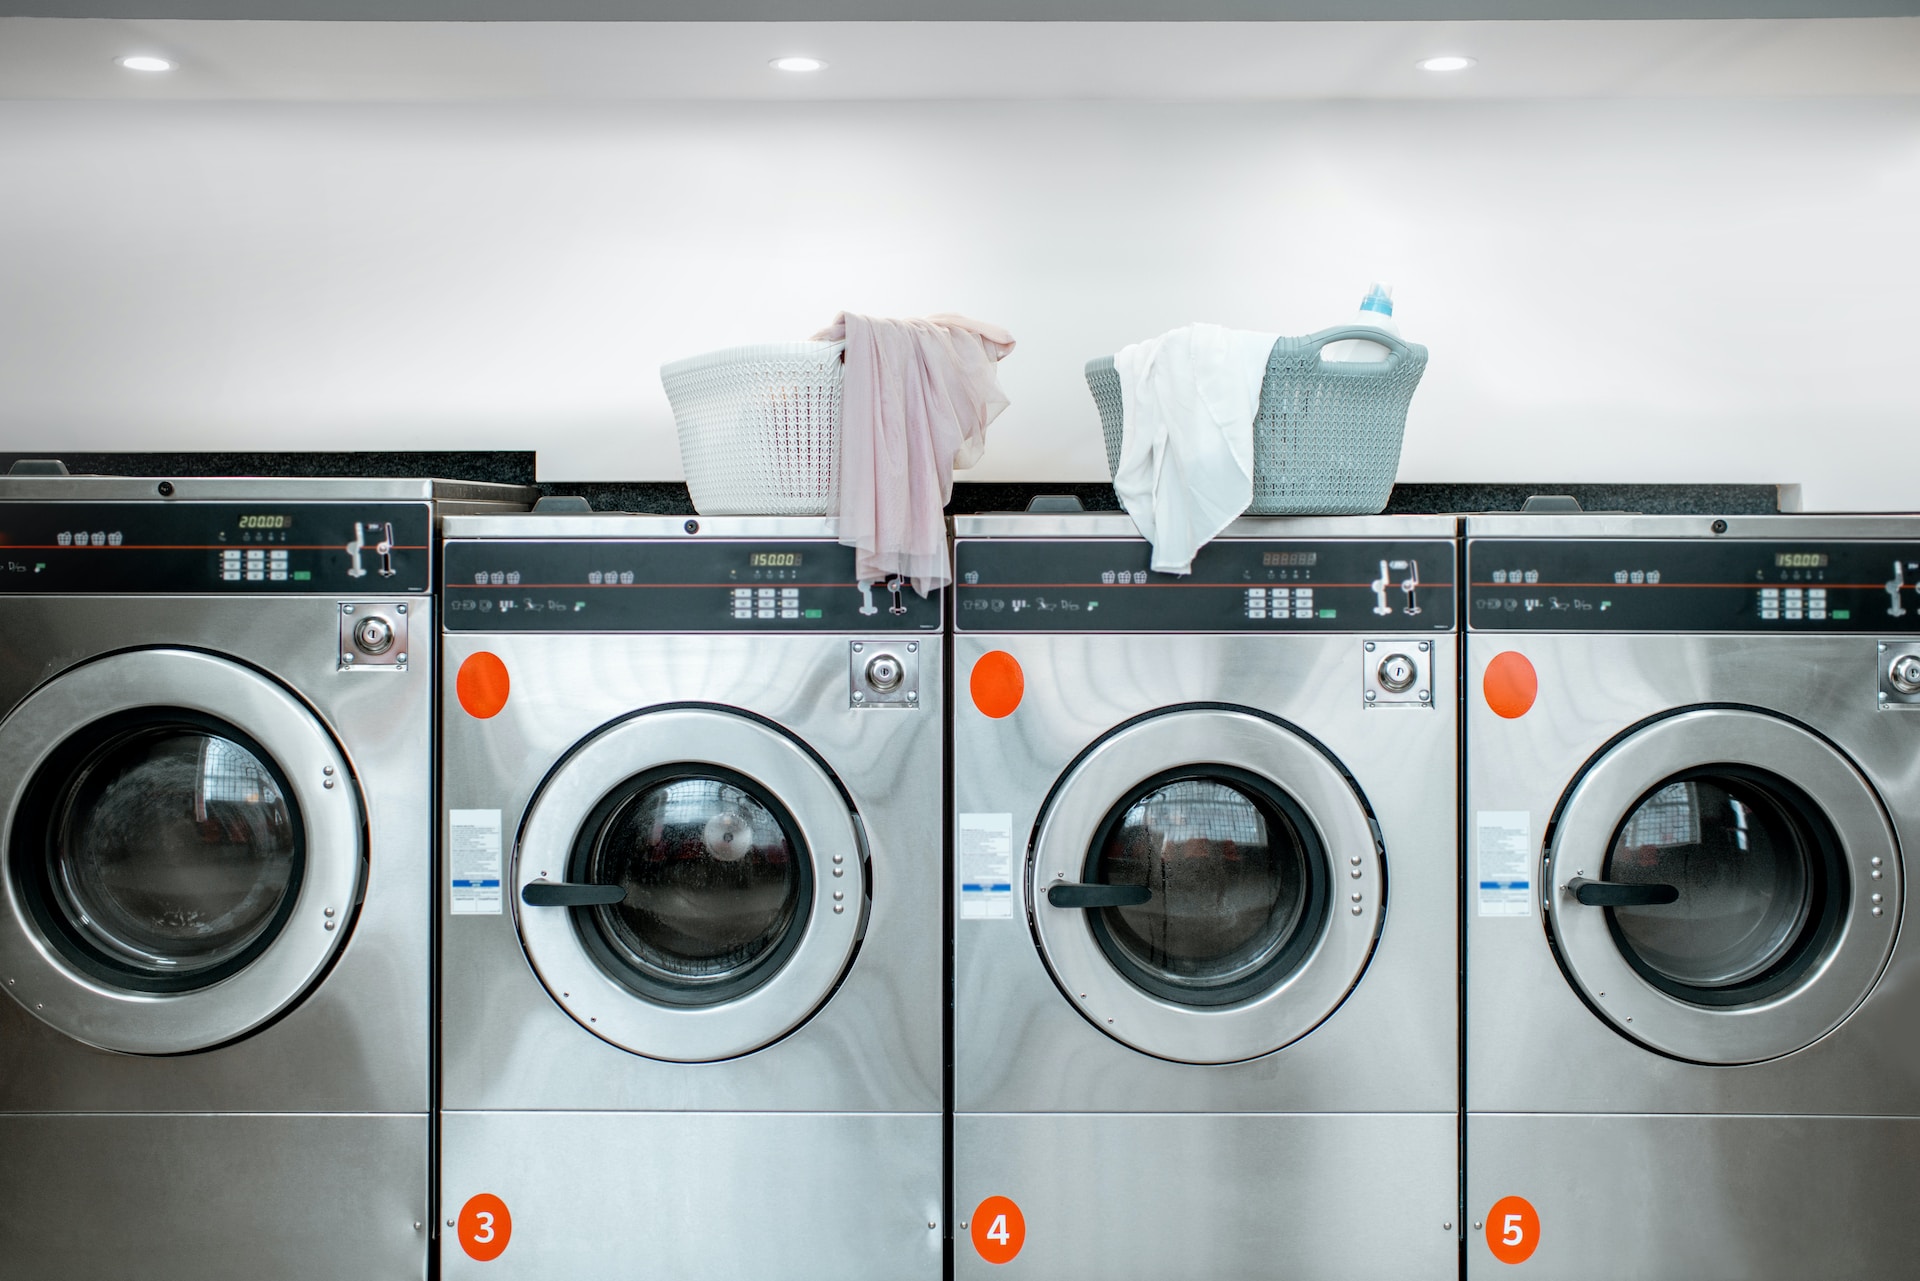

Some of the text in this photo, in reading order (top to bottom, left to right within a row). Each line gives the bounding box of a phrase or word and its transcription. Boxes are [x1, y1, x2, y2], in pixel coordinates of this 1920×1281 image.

[755, 553, 794, 566] 150.00
[473, 1211, 495, 1244] 3
[986, 1214, 1010, 1246] 4
[1502, 1214, 1524, 1247] 5
